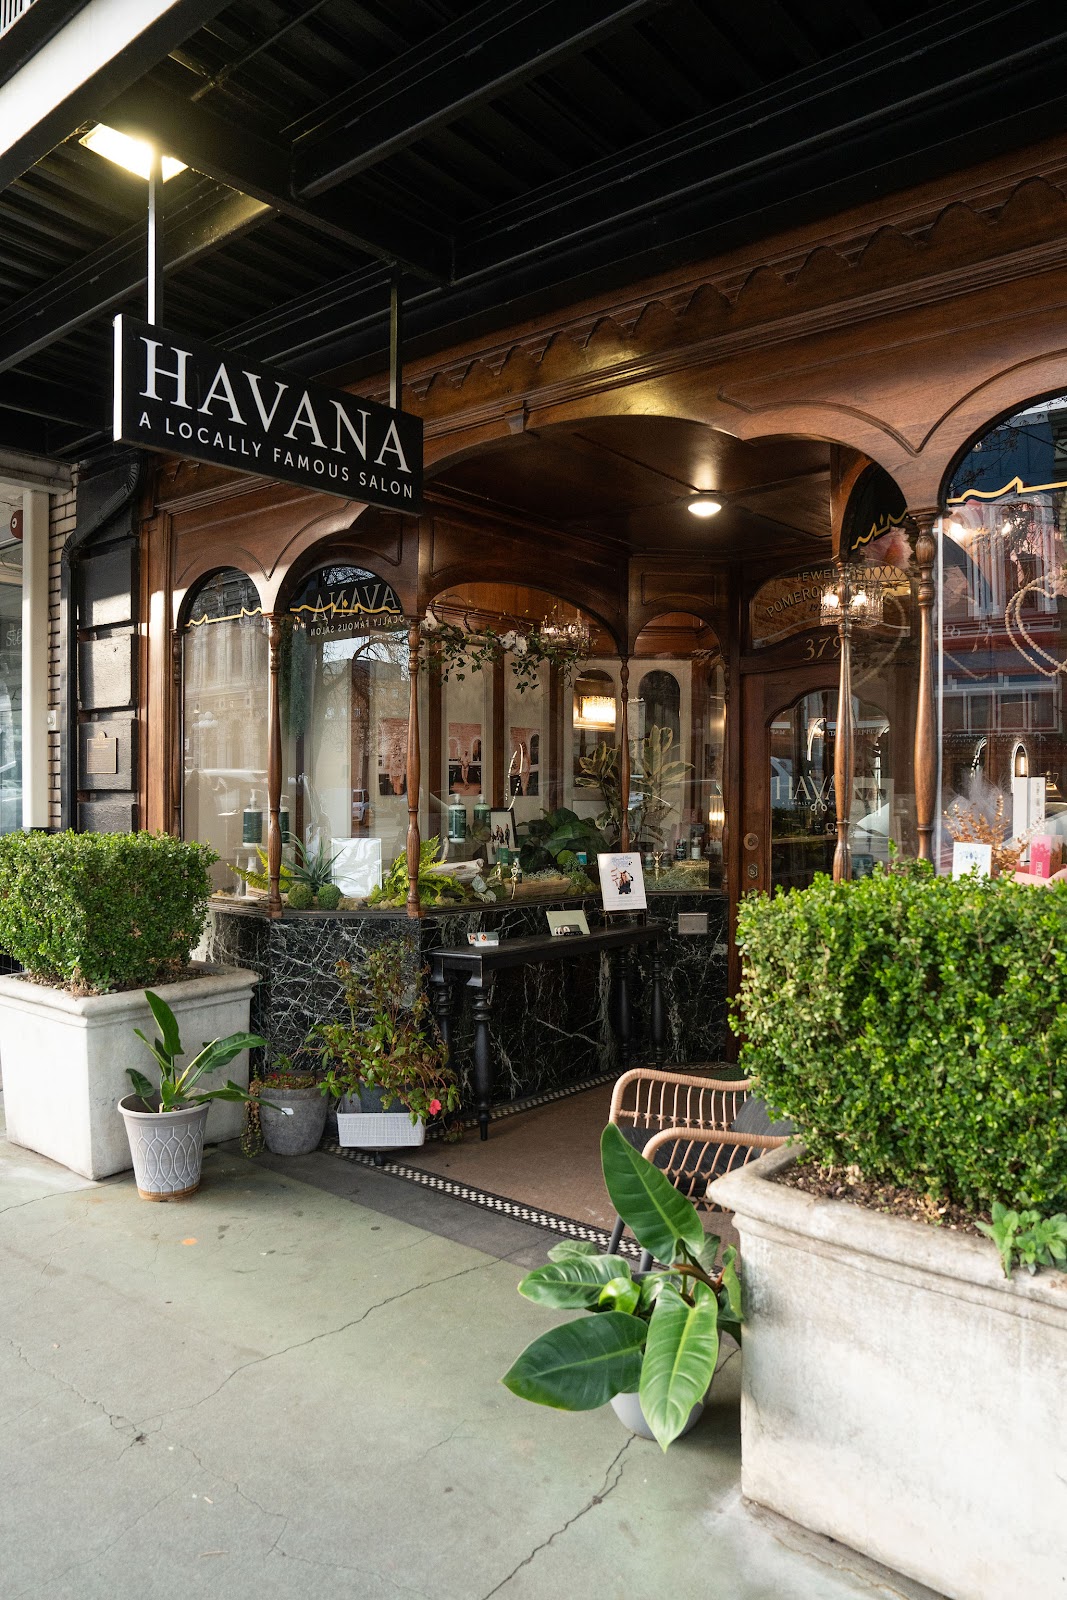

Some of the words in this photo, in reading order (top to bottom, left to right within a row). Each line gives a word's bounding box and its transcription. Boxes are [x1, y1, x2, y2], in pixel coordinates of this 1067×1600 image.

[139, 336, 412, 474] HAVANA
[139, 411, 151, 430] A
[165, 417, 262, 457] LOCALLY
[273, 448, 349, 482] FAMOUS
[359, 471, 413, 499] SALON
